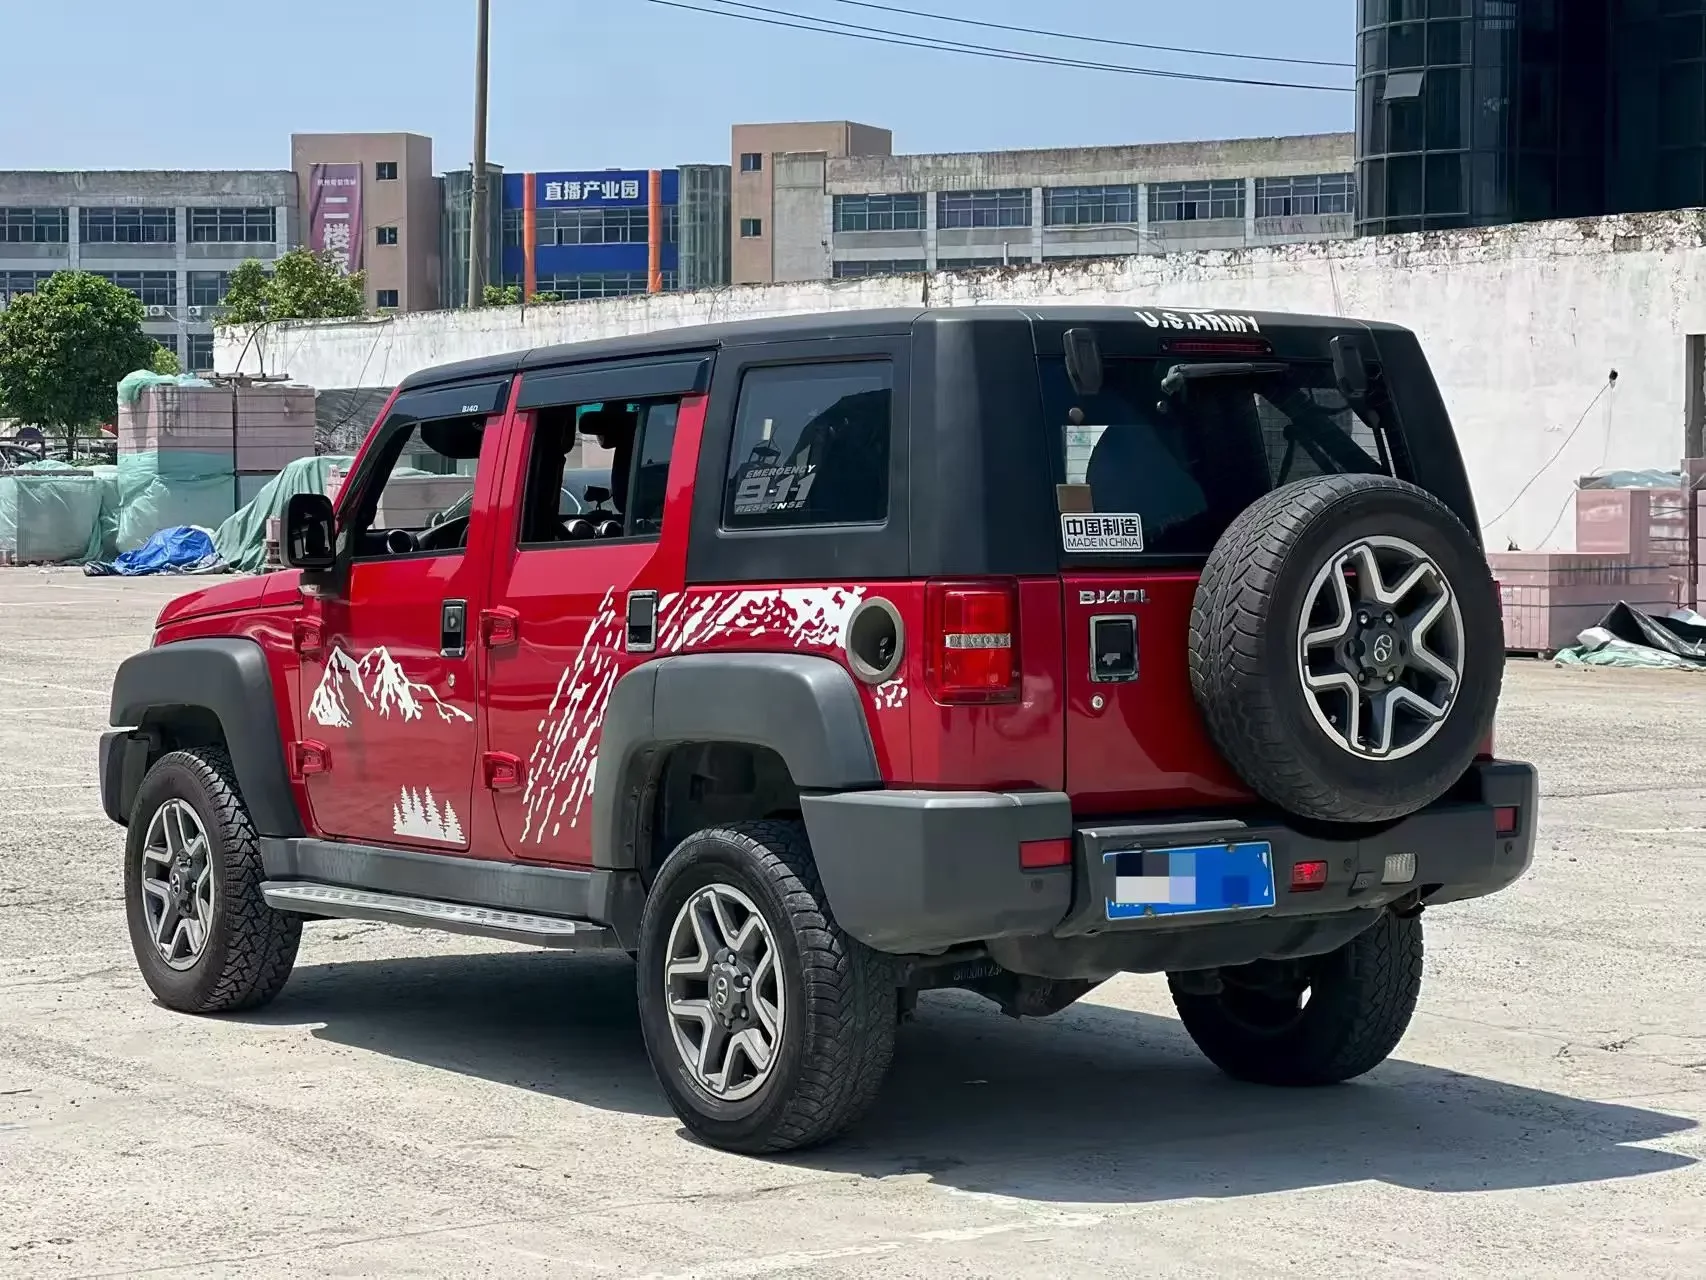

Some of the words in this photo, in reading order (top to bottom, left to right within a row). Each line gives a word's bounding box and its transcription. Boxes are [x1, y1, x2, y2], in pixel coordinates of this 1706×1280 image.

[545, 180, 639, 200] 直播产业园
[1134, 311, 1260, 333] U.S.ARMY
[735, 500, 805, 513] RESPONSE
[1065, 518, 1138, 537] 中国制造
[1067, 537, 1097, 547] MADE
[1099, 537, 1108, 547] IN
[1109, 537, 1139, 547] CHINA
[1078, 588, 1150, 605] BJ40L
